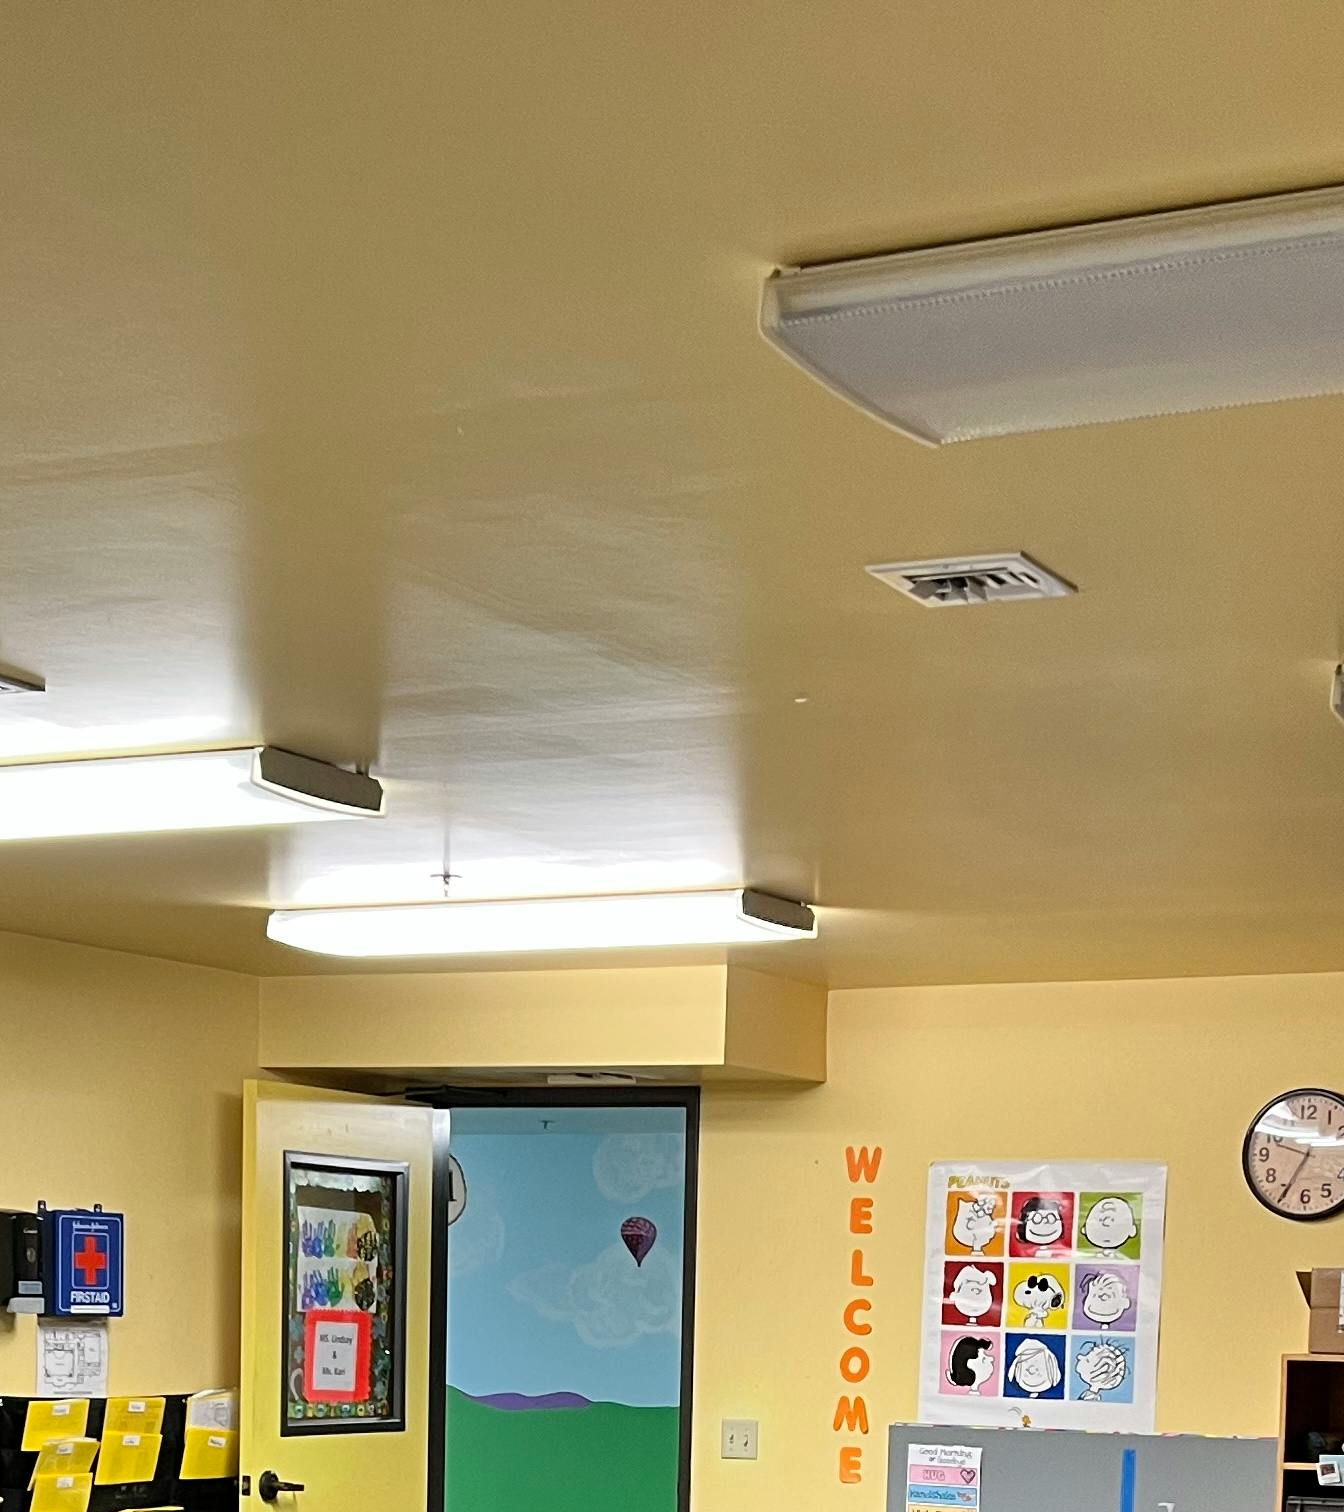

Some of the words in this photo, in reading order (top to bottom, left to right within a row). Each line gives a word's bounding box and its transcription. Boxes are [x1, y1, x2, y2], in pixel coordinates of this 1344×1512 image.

[1300, 1104, 1317, 1120] 12
[1327, 1109, 1332, 1125] 1
[1258, 1146, 1270, 1162] 9
[948, 1174, 1010, 1189] PEANUTS
[1265, 1167, 1277, 1183] 8
[1299, 1188, 1311, 1204] 6
[1319, 1183, 1332, 1199] 5
[832, 1146, 882, 1485] WELCOME
[922, 1469, 946, 1481] HUG
